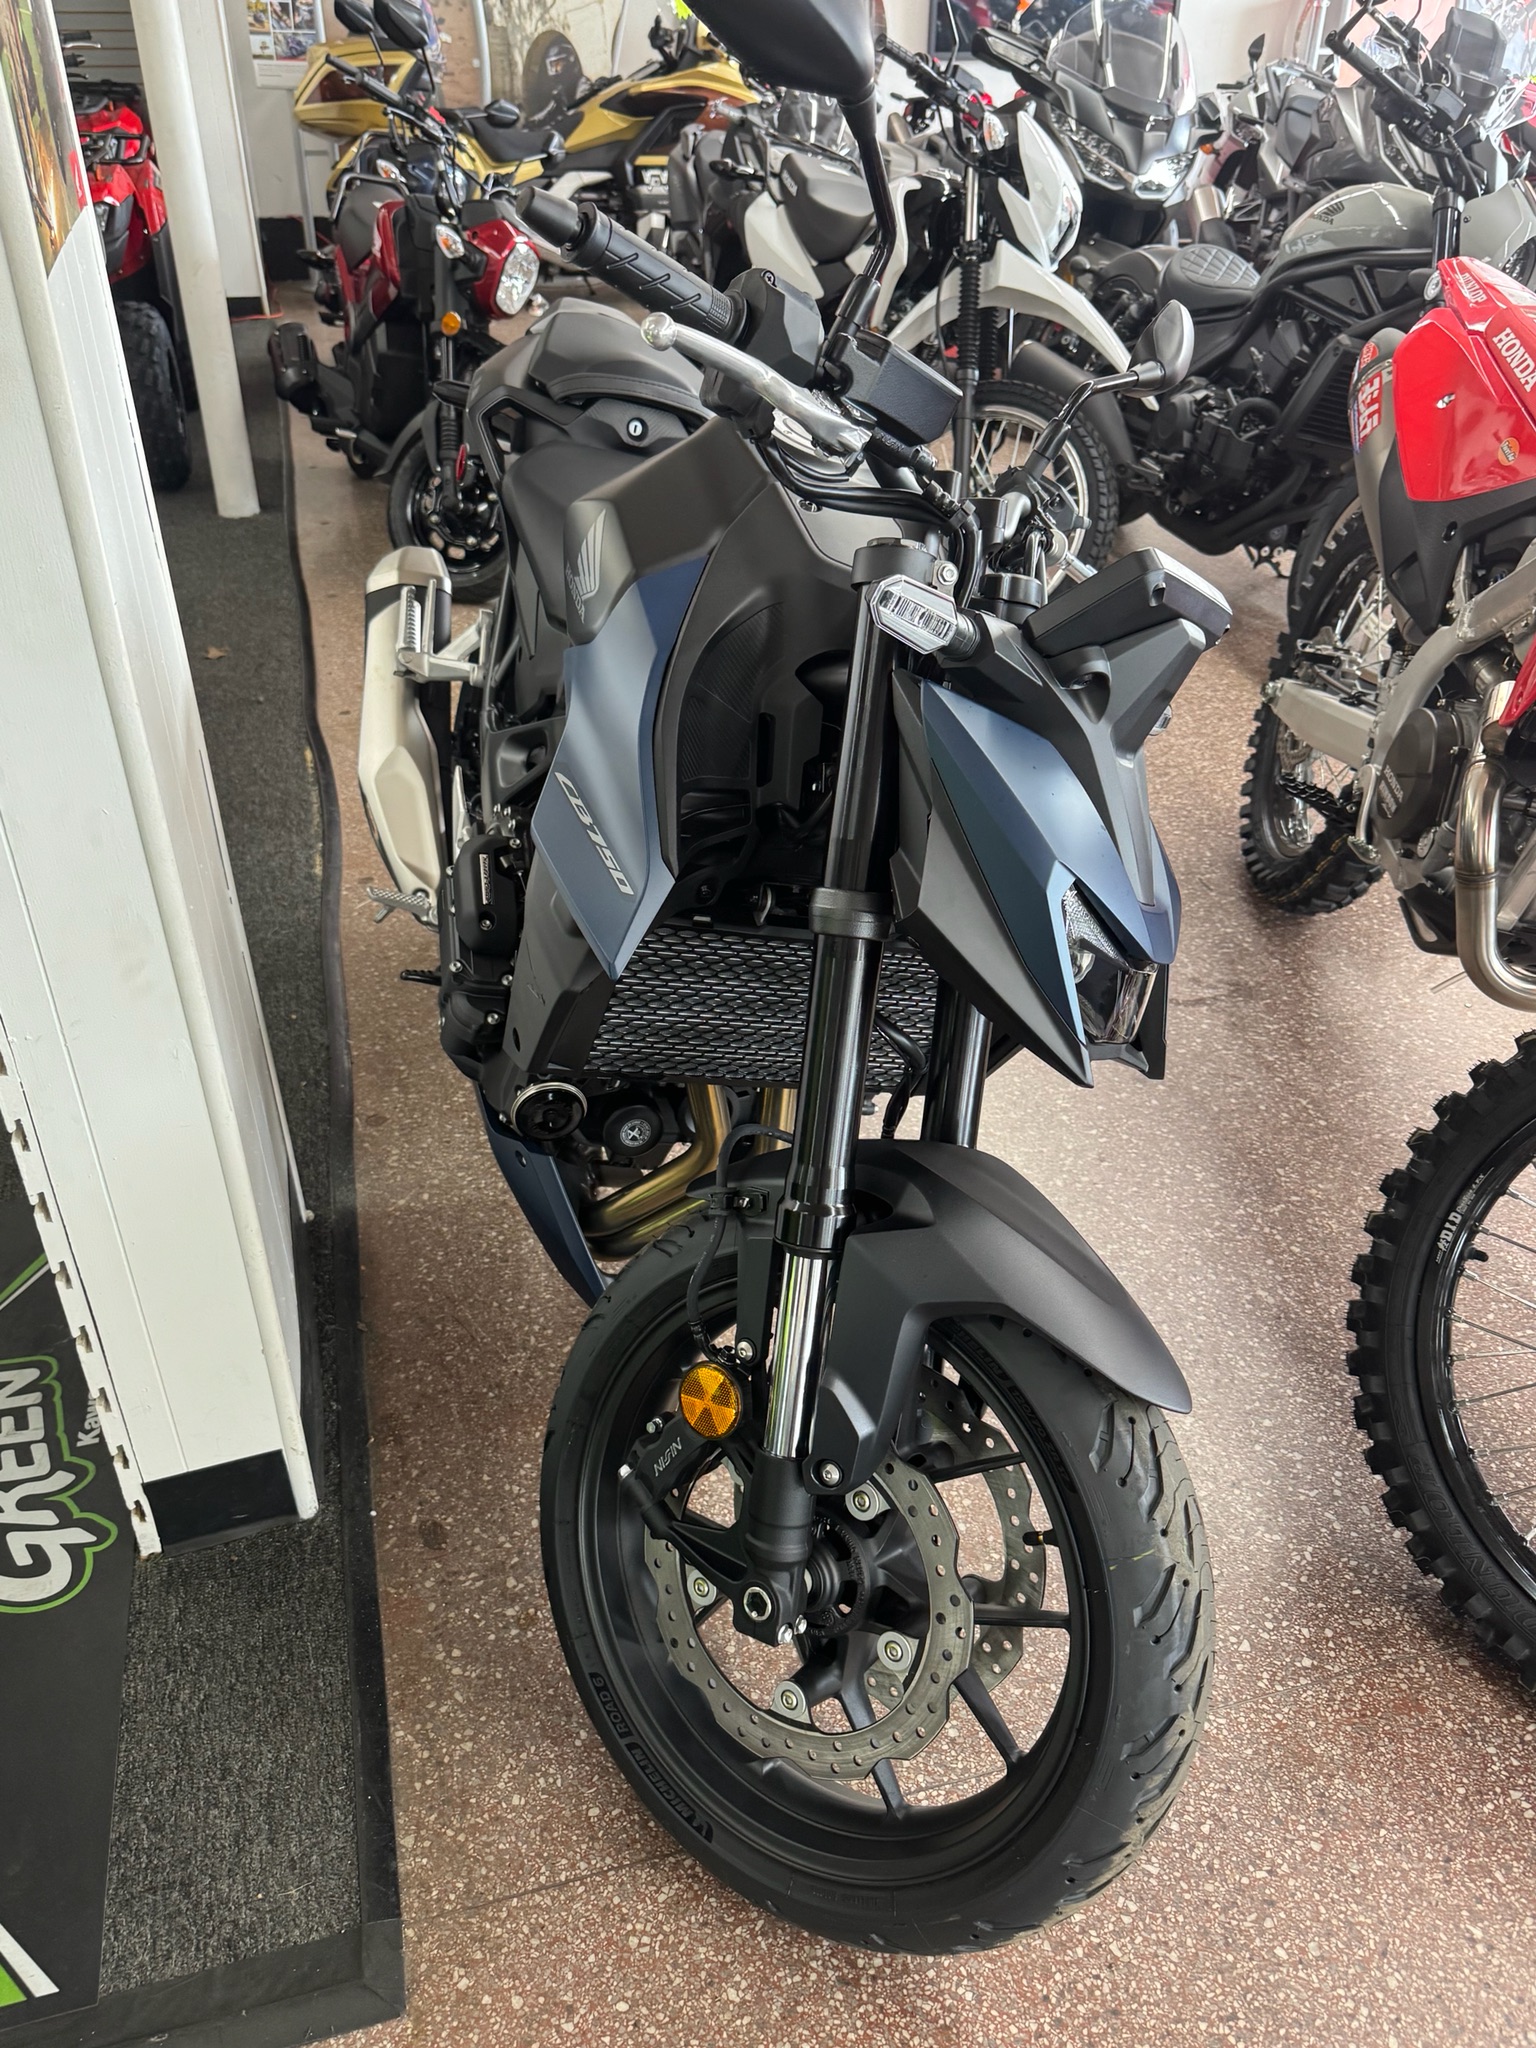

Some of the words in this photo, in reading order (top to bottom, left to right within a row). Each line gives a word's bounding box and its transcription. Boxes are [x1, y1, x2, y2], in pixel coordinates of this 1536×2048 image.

[565, 559, 586, 624] HONDA
[1383, 764, 1404, 803] HONDA
[554, 771, 635, 896] CB750
[592, 1676, 605, 1688] 6
[599, 1689, 630, 1737] ROAD
[631, 1747, 695, 1819] MICHELIN
